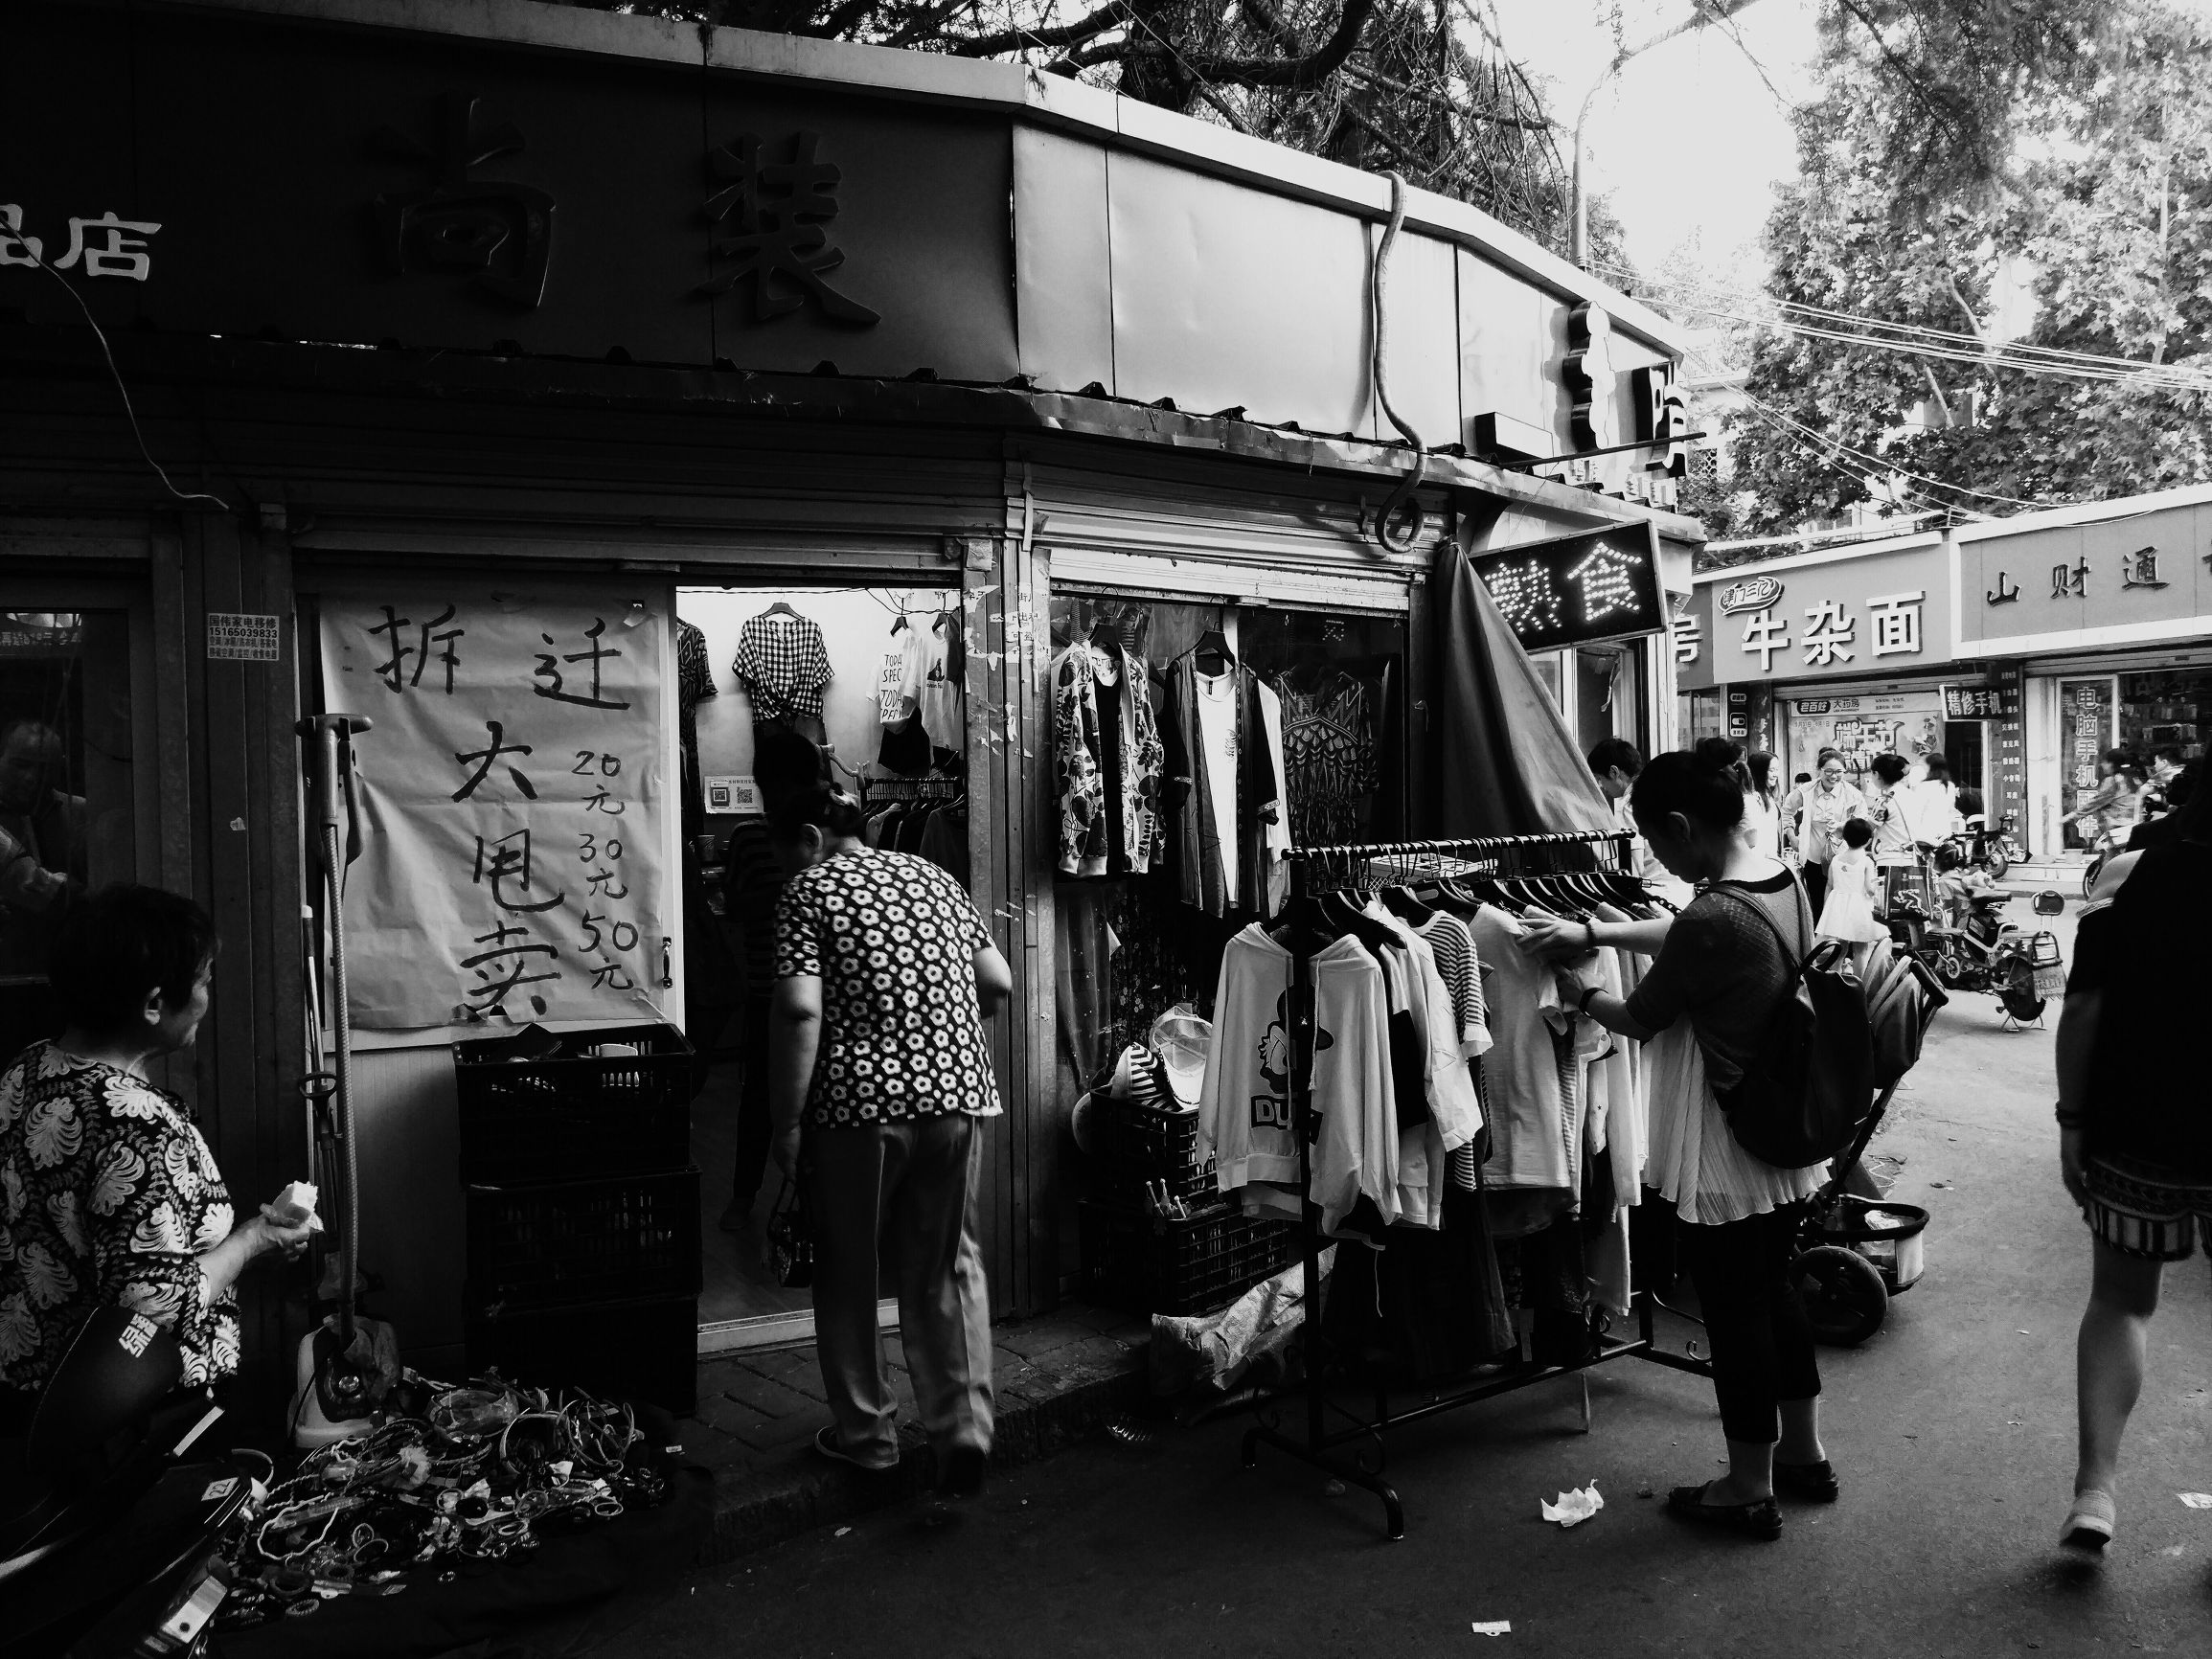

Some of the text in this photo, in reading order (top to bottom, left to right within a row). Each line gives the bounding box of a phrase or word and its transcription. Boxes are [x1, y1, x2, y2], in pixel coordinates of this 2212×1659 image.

[1987, 538, 2212, 606] 山财通
[209, 626, 278, 639] 15165039833
[1742, 591, 1926, 670] 牛杂面
[883, 654, 903, 668] TODA
[1947, 690, 2002, 716] 精修手机
[1834, 717, 1904, 751] 端午节
[572, 749, 622, 778] 20
[584, 784, 626, 816] 元
[578, 833, 623, 862] 30
[451, 720, 565, 1016] 大甩卖
[586, 868, 628, 899] 元
[579, 910, 639, 952] 50
[590, 958, 634, 990] 元
